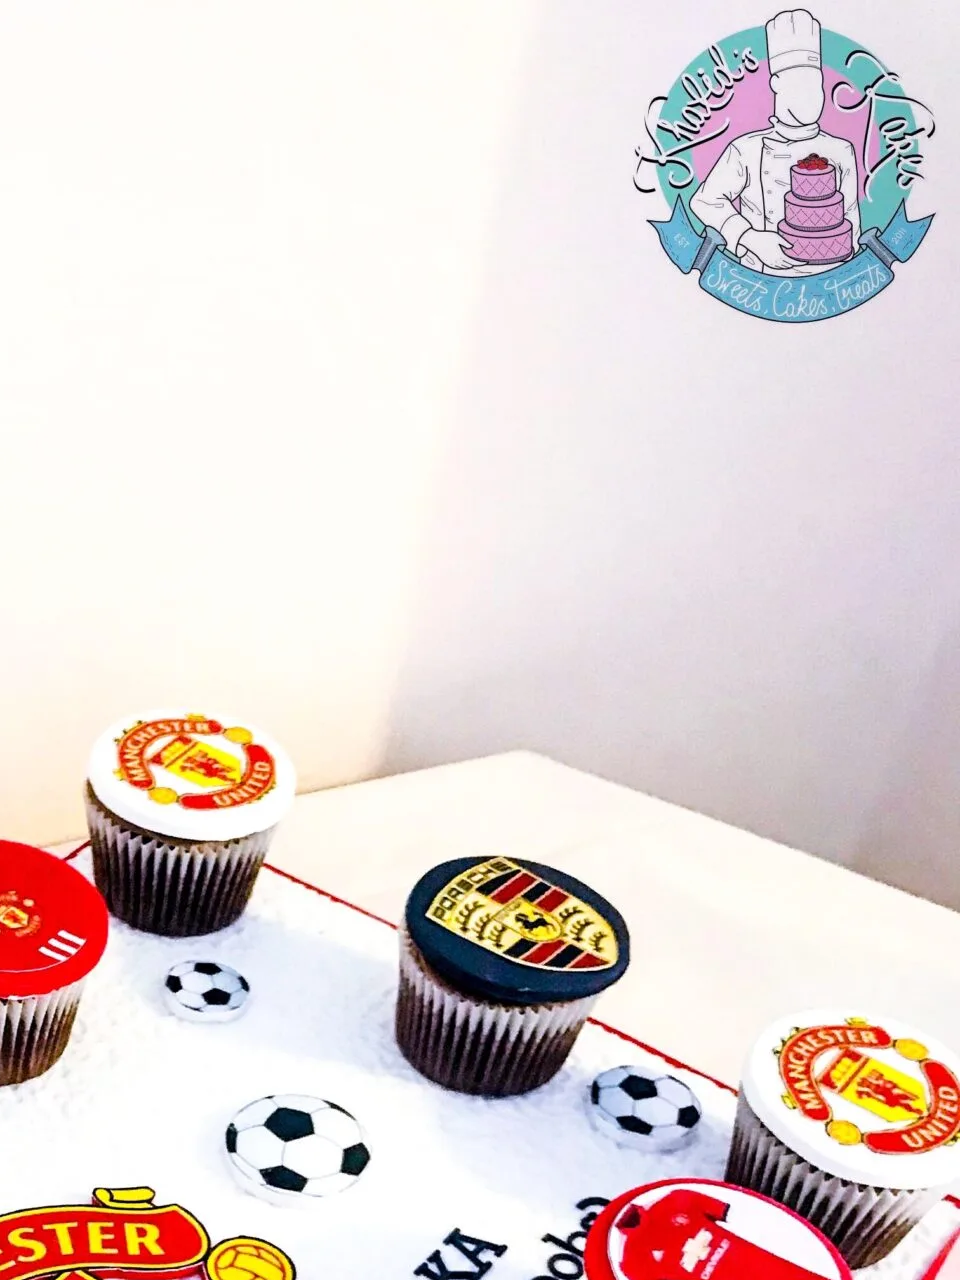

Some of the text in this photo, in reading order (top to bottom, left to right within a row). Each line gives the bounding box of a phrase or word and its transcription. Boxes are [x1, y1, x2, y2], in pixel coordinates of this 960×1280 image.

[123, 722, 271, 807] MANCHESTER UNITED
[432, 860, 512, 921] PORSCHE
[788, 1029, 960, 1148] MANCHESTER UNITED
